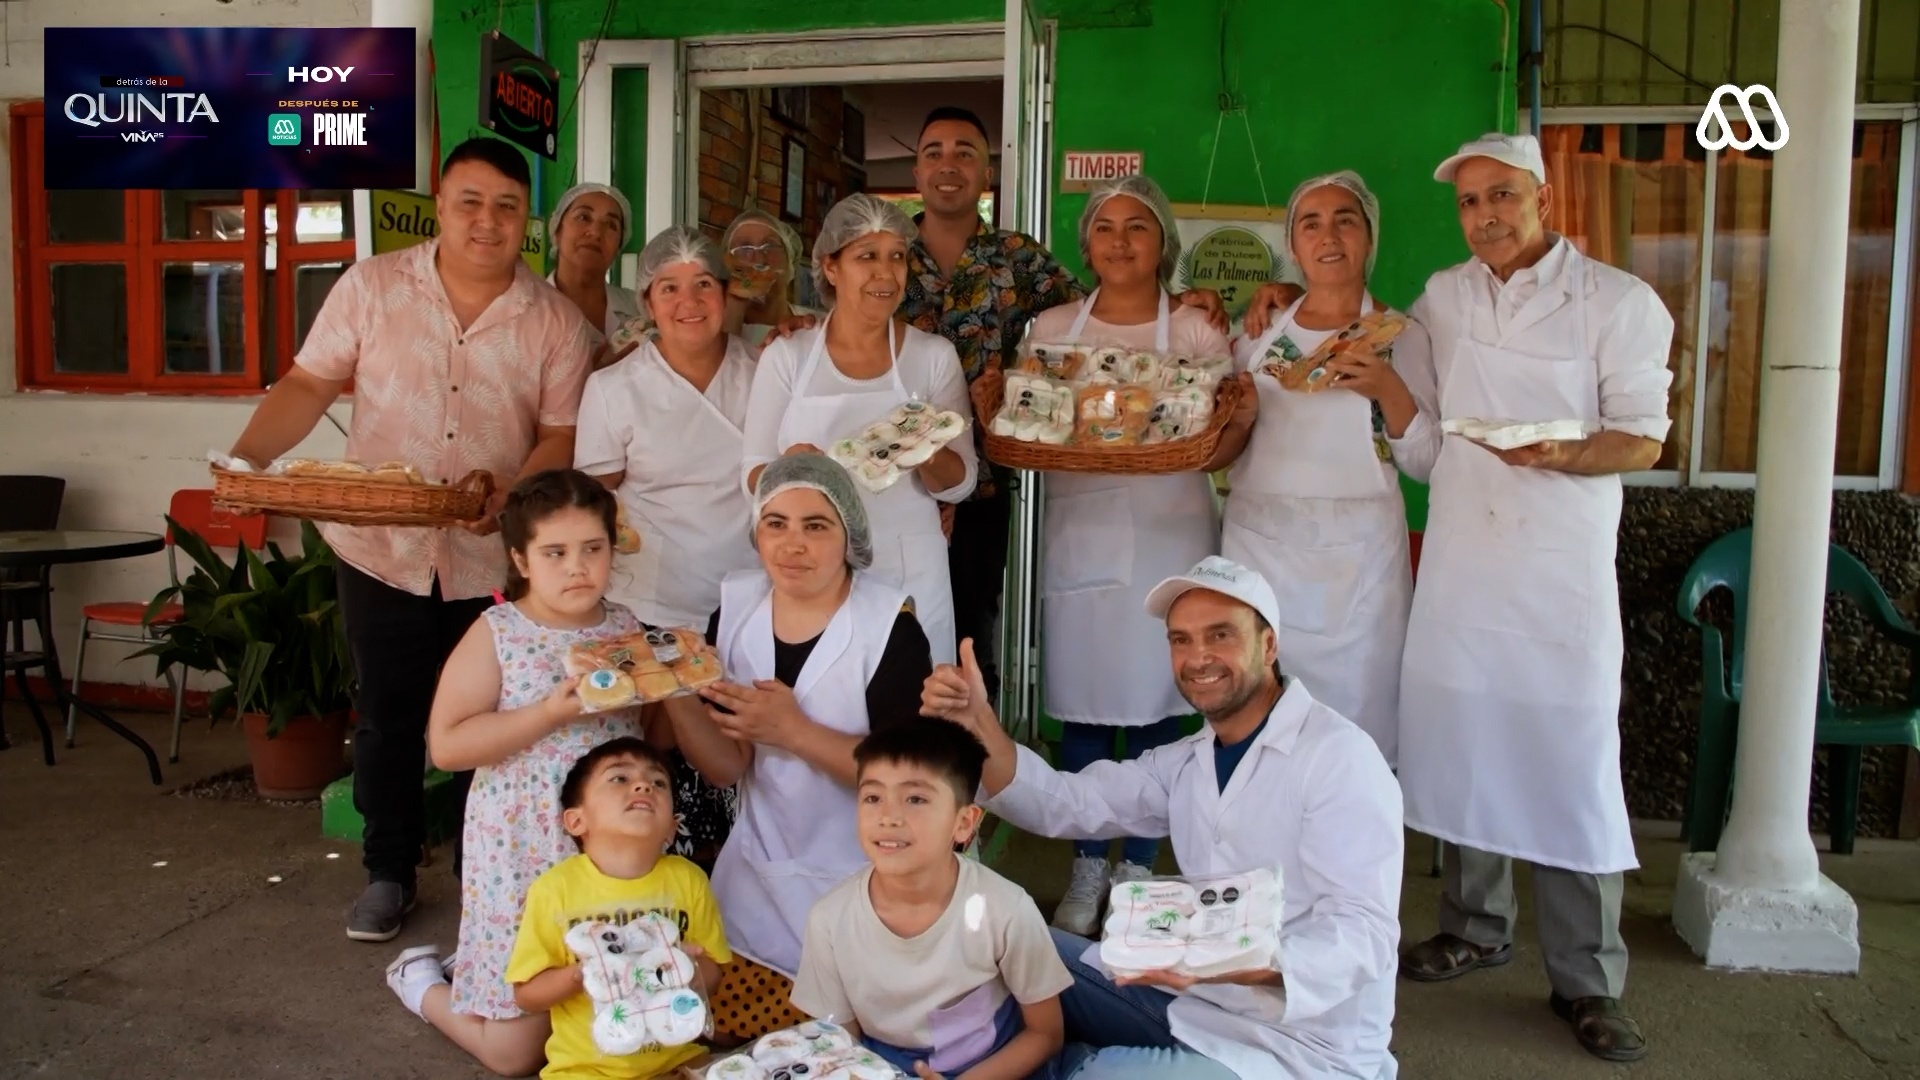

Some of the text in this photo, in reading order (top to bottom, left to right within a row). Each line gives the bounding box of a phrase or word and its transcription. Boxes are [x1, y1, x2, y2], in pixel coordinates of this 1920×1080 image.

[497, 71, 553, 127] ABIERTO
[1067, 155, 1139, 179] TIMBRE
[379, 201, 436, 238] Sala
[1204, 250, 1263, 260] de Dulces
[1193, 260, 1269, 282] Las Palmeras
